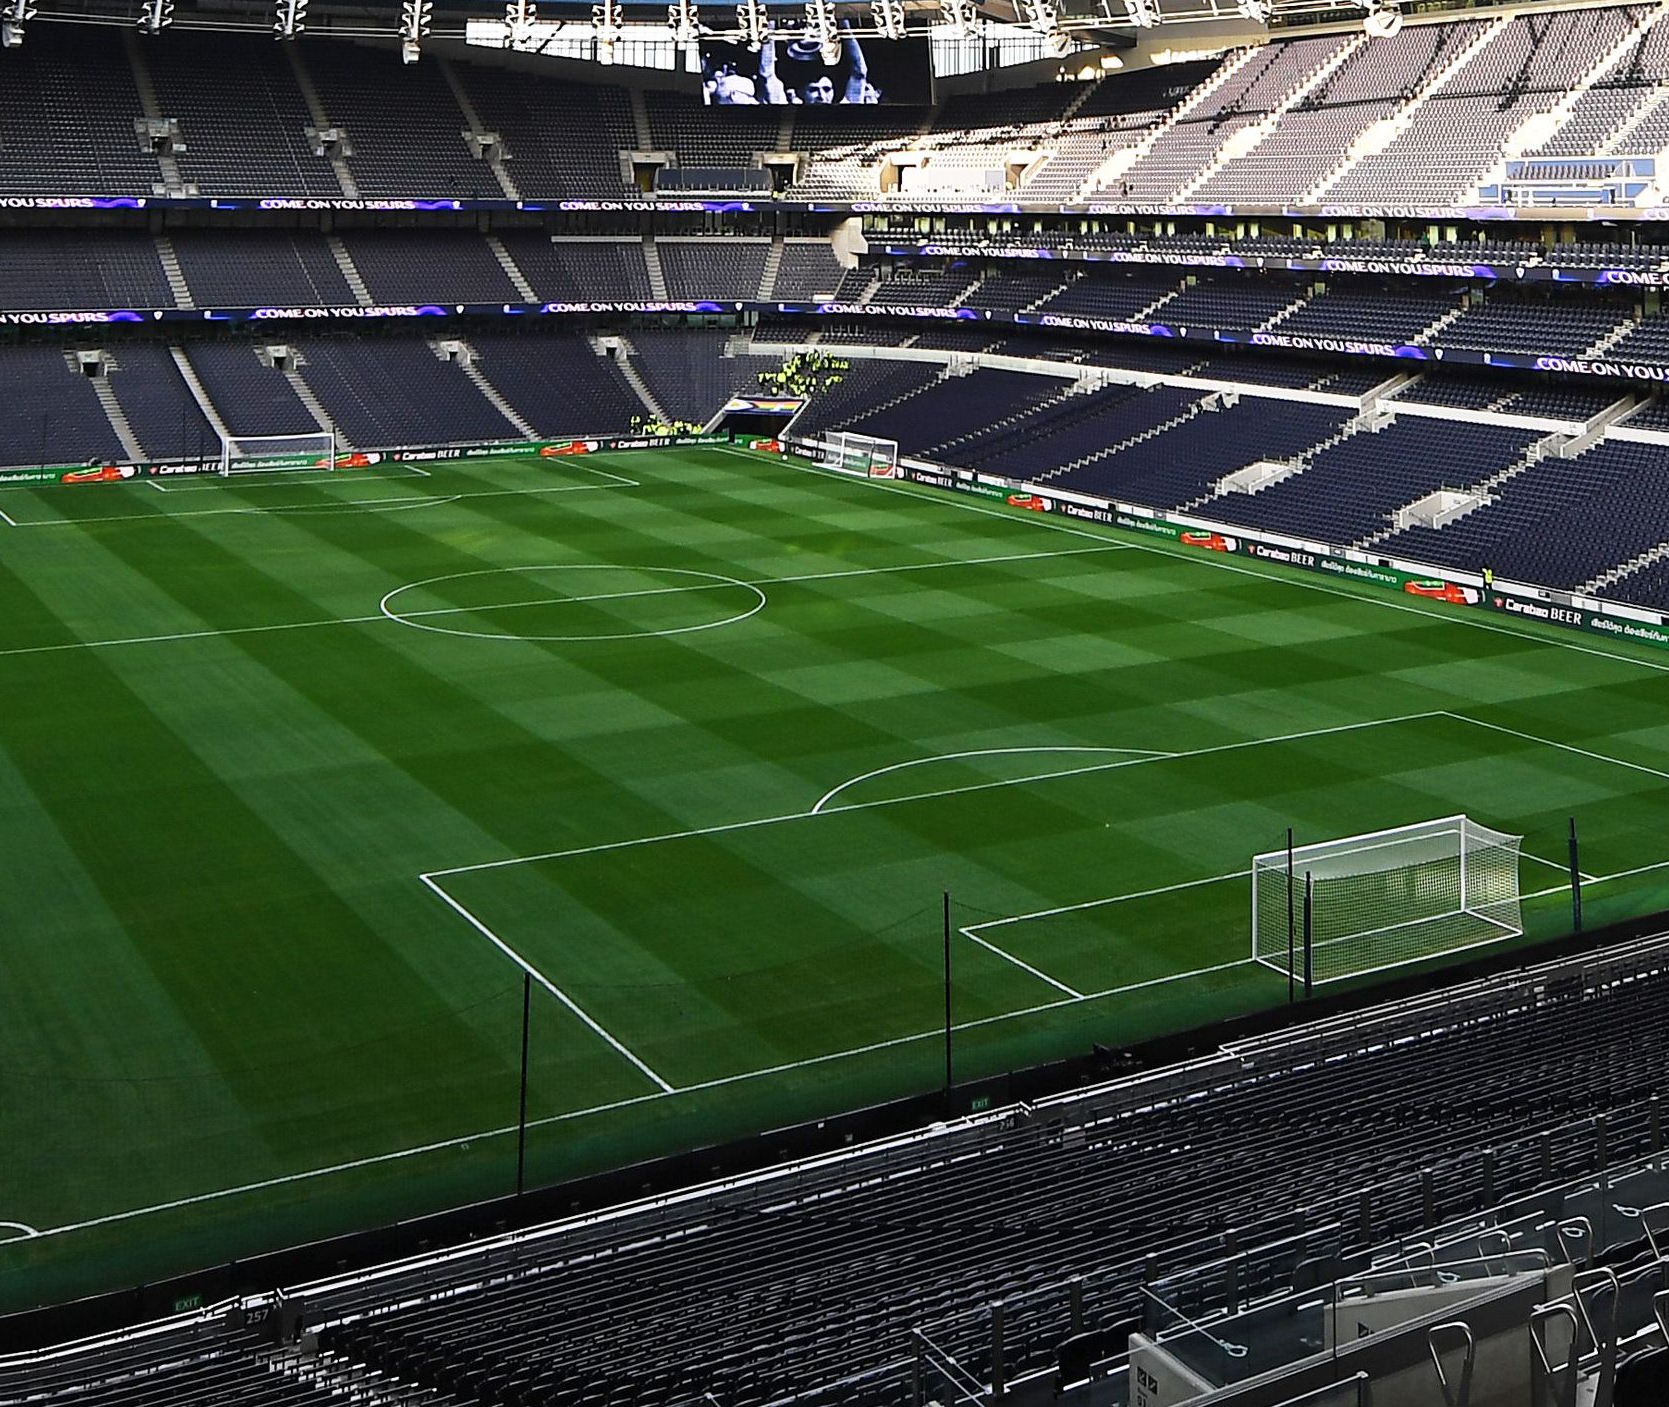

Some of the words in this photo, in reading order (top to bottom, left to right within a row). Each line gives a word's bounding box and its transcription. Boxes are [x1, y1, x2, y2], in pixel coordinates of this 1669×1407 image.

[35, 196, 94, 208] SPURS
[260, 200, 306, 210] COME
[306, 200, 331, 210] ON
[364, 200, 415, 210] SPURS
[560, 201, 601, 212] COME
[601, 201, 623, 212] ON
[656, 201, 704, 212] SPURS
[1327, 261, 1368, 273] COME
[1368, 262, 1390, 274] ON
[1417, 265, 1474, 277] SPURS
[1607, 271, 1660, 285] COME
[255, 308, 304, 318] COME
[304, 308, 329, 318] ON
[365, 306, 418, 316] SPURS
[549, 303, 590, 312] COME
[590, 302, 612, 312] ON
[823, 304, 861, 314] COME
[862, 305, 886, 315] ON
[48, 312, 109, 323] SPURS
[1253, 334, 1292, 346] COME
[1292, 336, 1313, 349] ON
[1345, 342, 1395, 356] SPURS
[1537, 357, 1589, 373] COME
[1591, 361, 1620, 376] ON
[1620, 364, 1664, 381] YOU
[1291, 552, 1315, 567] BEER
[1505, 598, 1549, 618] Carabao
[1550, 607, 1582, 626] BEER
[175, 1296, 200, 1311] EXIT
[246, 1309, 269, 1324] 257
